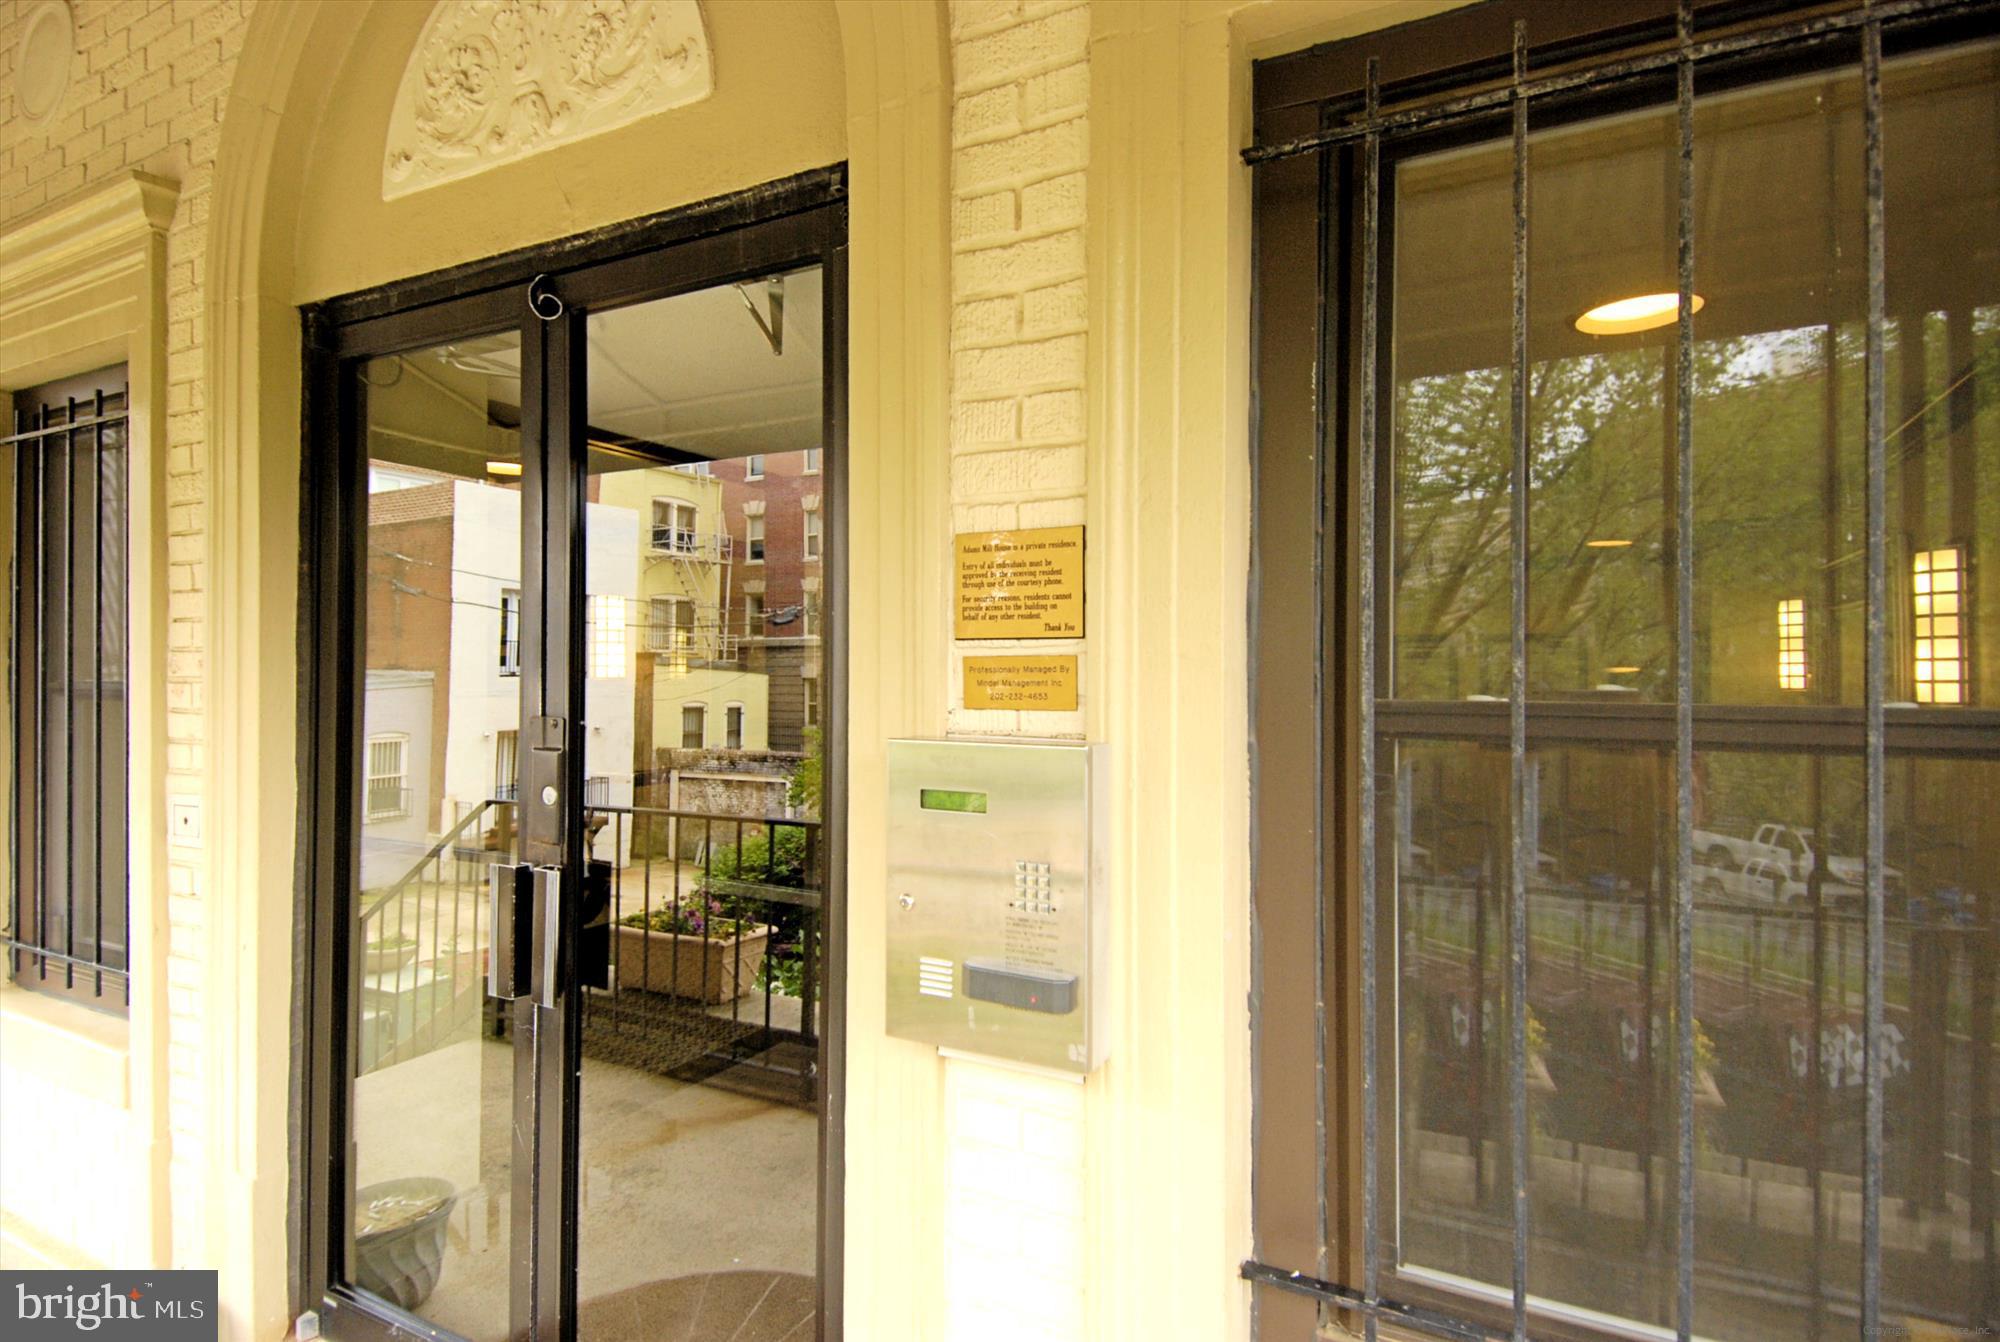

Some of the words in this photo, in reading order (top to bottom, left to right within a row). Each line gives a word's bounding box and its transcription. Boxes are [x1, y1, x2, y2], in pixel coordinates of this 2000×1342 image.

[994, 544, 1011, 552] House
[1026, 543, 1046, 552] private
[962, 562, 978, 572] Entry
[979, 561, 986, 570] of
[996, 560, 1026, 568] individuals
[1045, 558, 1052, 566] be
[962, 571, 988, 581] approved
[990, 571, 997, 580] by
[1010, 570, 1036, 579] receiving
[1039, 568, 1062, 576] resident
[962, 581, 984, 590] through
[997, 579, 1004, 587] of
[1017, 579, 1041, 588] courtesy
[962, 595, 971, 603] For
[974, 595, 995, 604] security
[1024, 592, 1050, 601] residents
[1052, 592, 1072, 601] cannot
[962, 604, 983, 614] provide
[1013, 603, 1022, 611] the
[1024, 602, 1048, 612] building
[962, 612, 979, 621] behalf
[981, 612, 987, 620] of
[988, 615, 998, 623] any
[1000, 612, 1015, 620] other
[1044, 623, 1061, 632] Thank
[1064, 623, 1075, 631] You
[969, 665, 1020, 674] Professionally
[1023, 665, 1057, 674] Managed
[1060, 665, 1070, 674] By
[1002, 680, 1048, 688] Management
